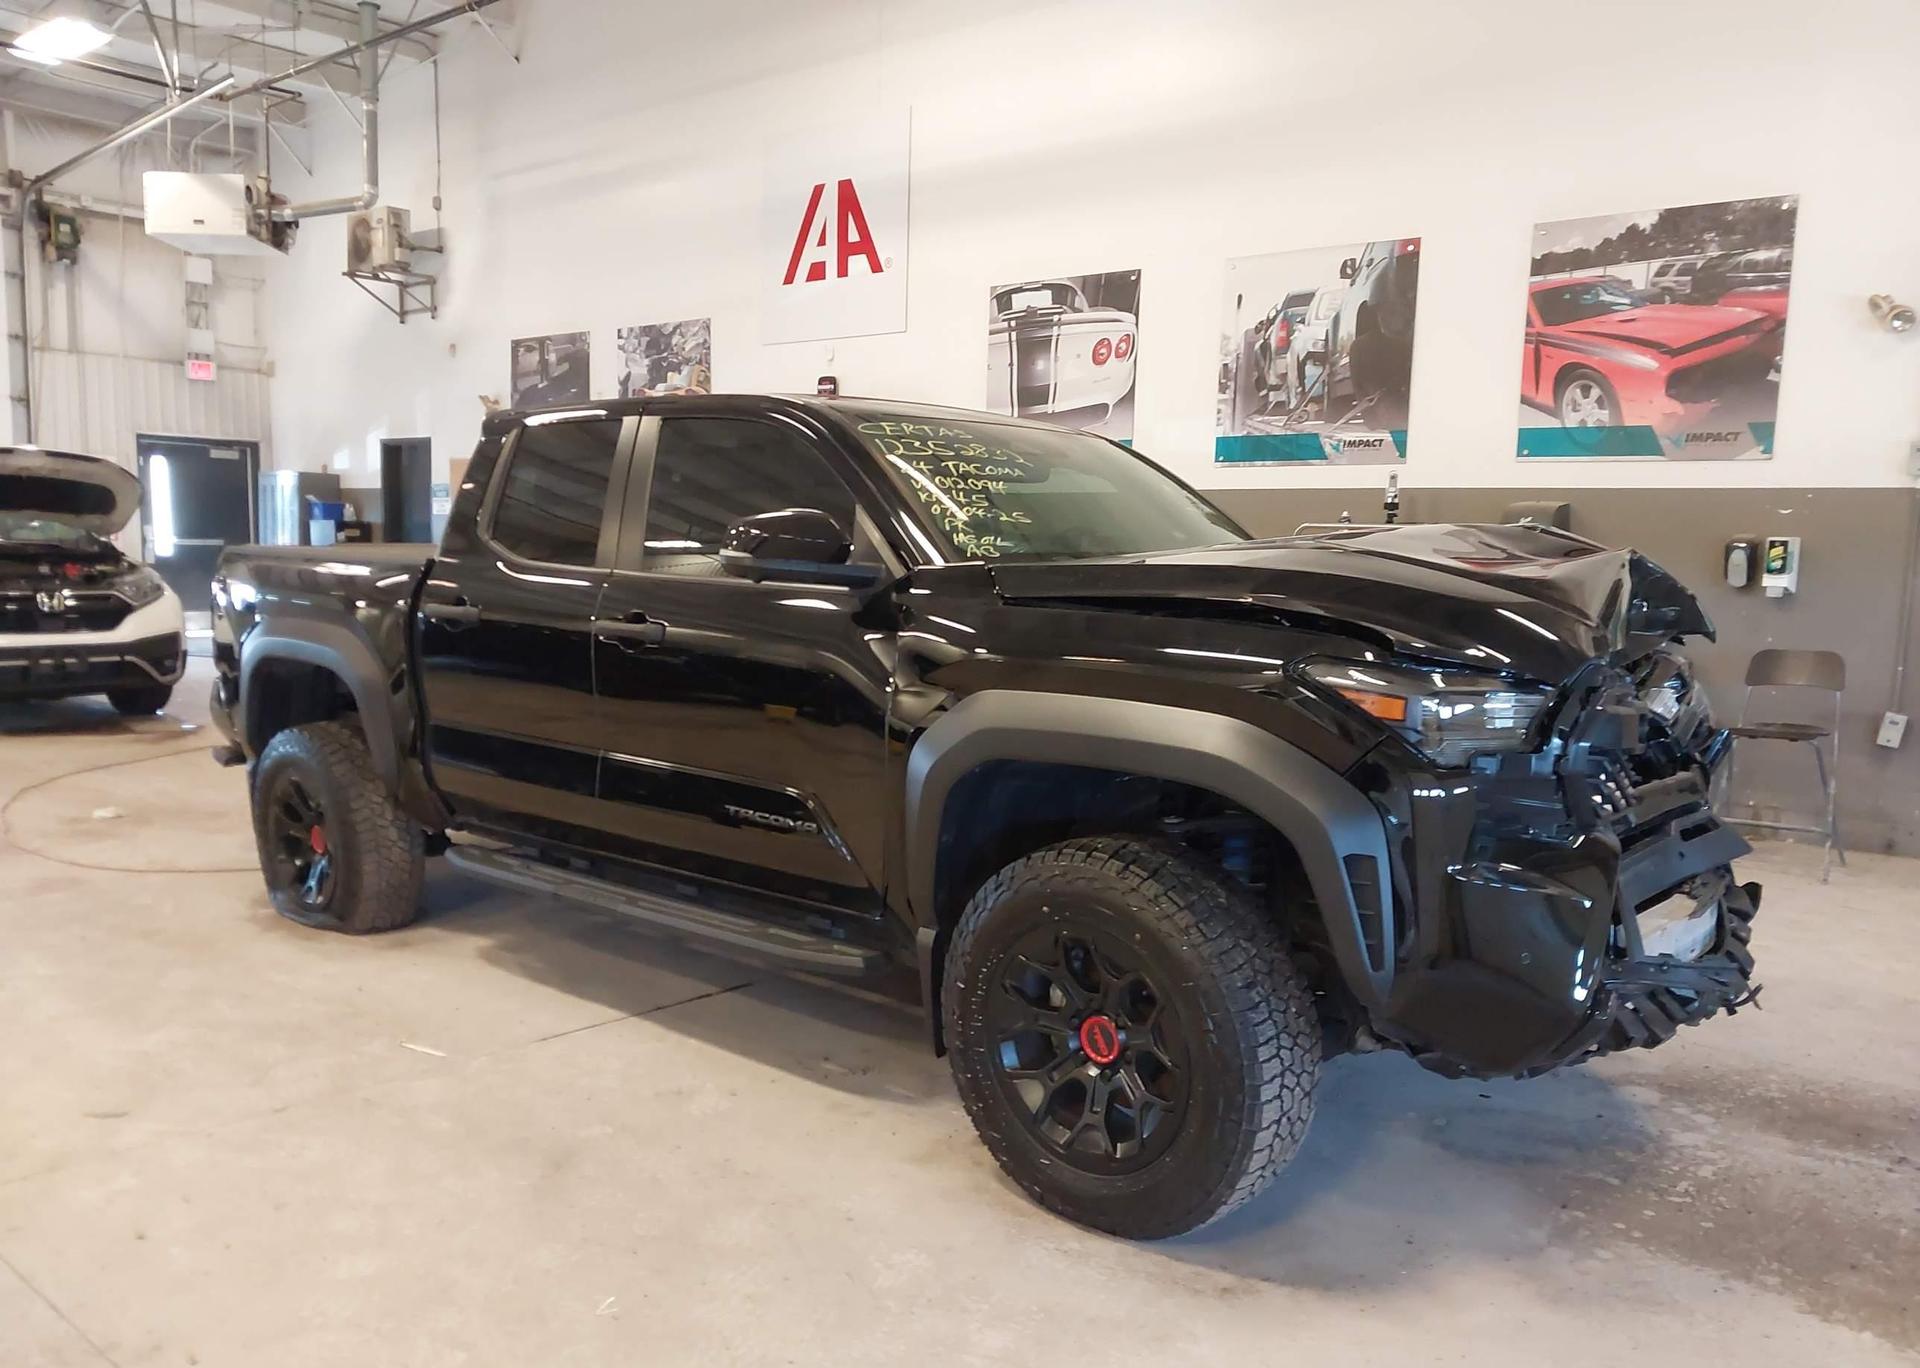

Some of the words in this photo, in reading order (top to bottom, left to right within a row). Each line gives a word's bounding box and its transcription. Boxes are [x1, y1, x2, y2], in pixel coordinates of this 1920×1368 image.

[1343, 438, 1385, 449] IMPACT
[1684, 431, 1742, 443] IMPACT
[941, 461, 1026, 477] TACOMA
[723, 804, 818, 833] TACOMA
